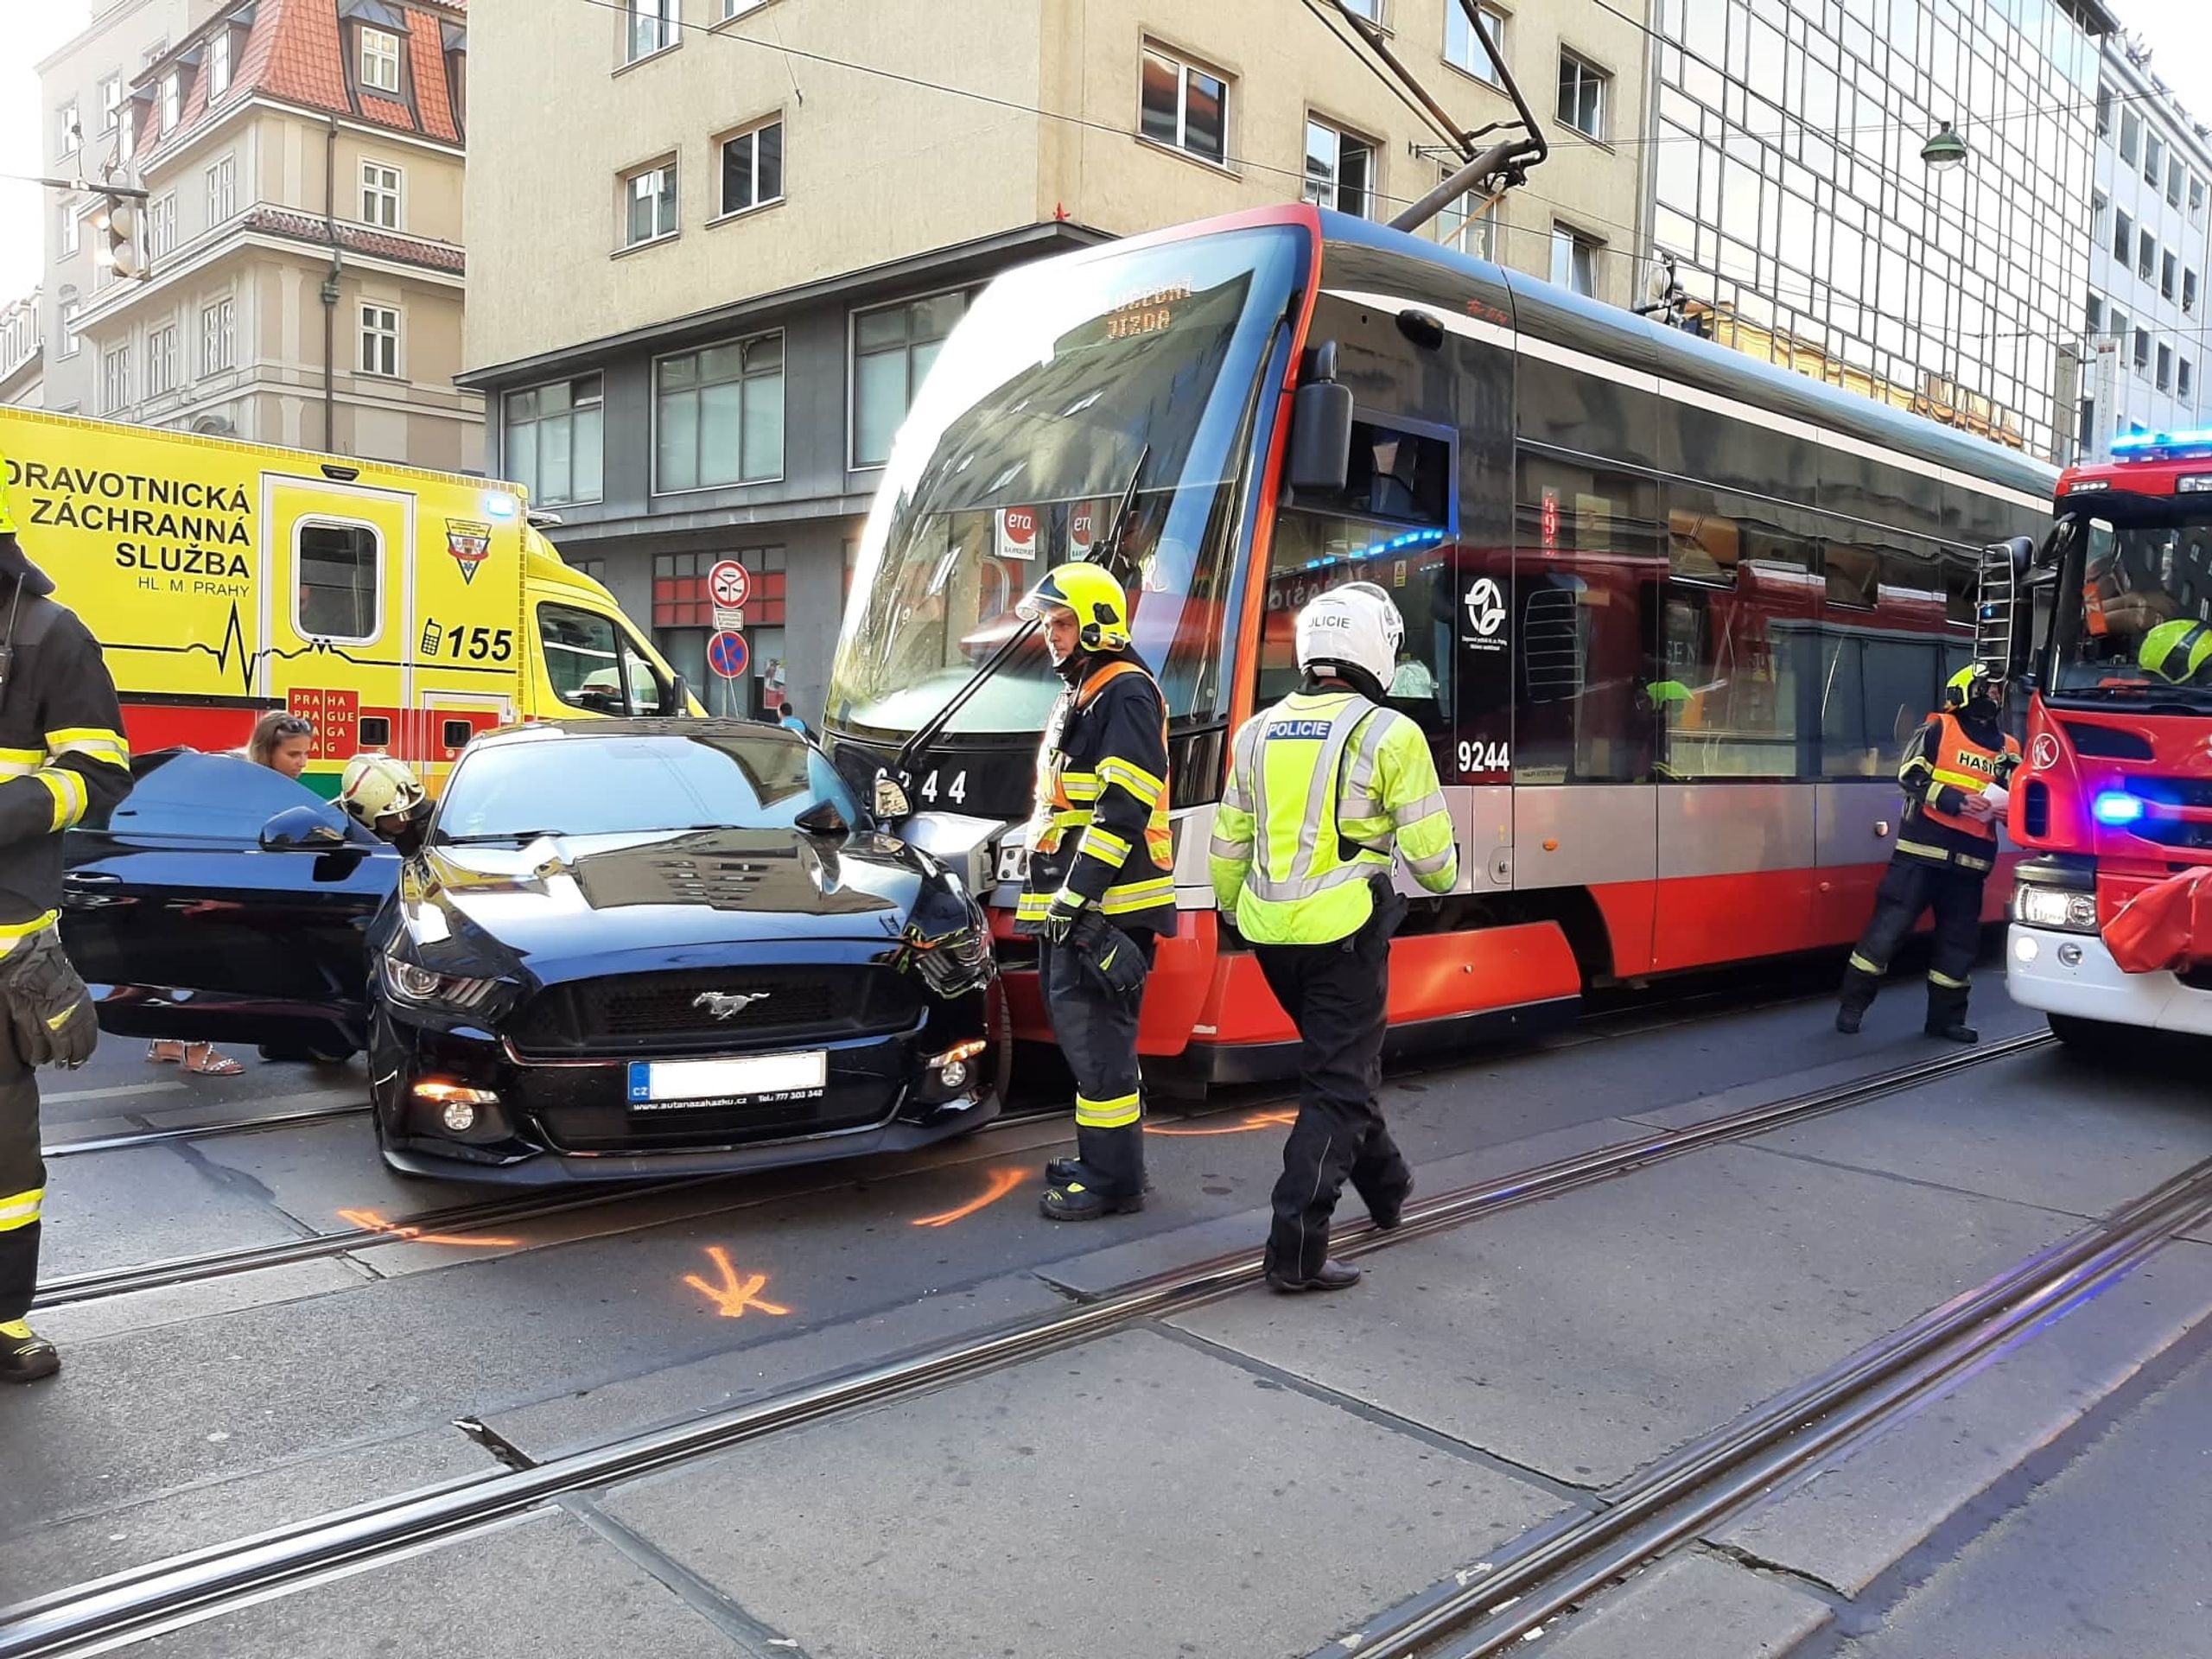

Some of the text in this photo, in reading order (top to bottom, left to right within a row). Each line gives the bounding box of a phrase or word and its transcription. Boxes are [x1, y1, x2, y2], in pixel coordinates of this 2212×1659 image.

[30, 495, 250, 546] ZÁCHRANNÁ
[1008, 513, 1032, 530] era
[116, 543, 250, 578] SLUŽBA
[138, 576, 250, 597] HL. M. PRAHY
[448, 626, 512, 661] 155
[294, 694, 346, 706] PRA HA
[327, 711, 355, 722] GUE
[327, 727, 346, 737] GA
[1268, 721, 1330, 737] POLICIE
[327, 742, 336, 752] G
[1458, 741, 1510, 772] 9244
[632, 1087, 648, 1096] CZ
